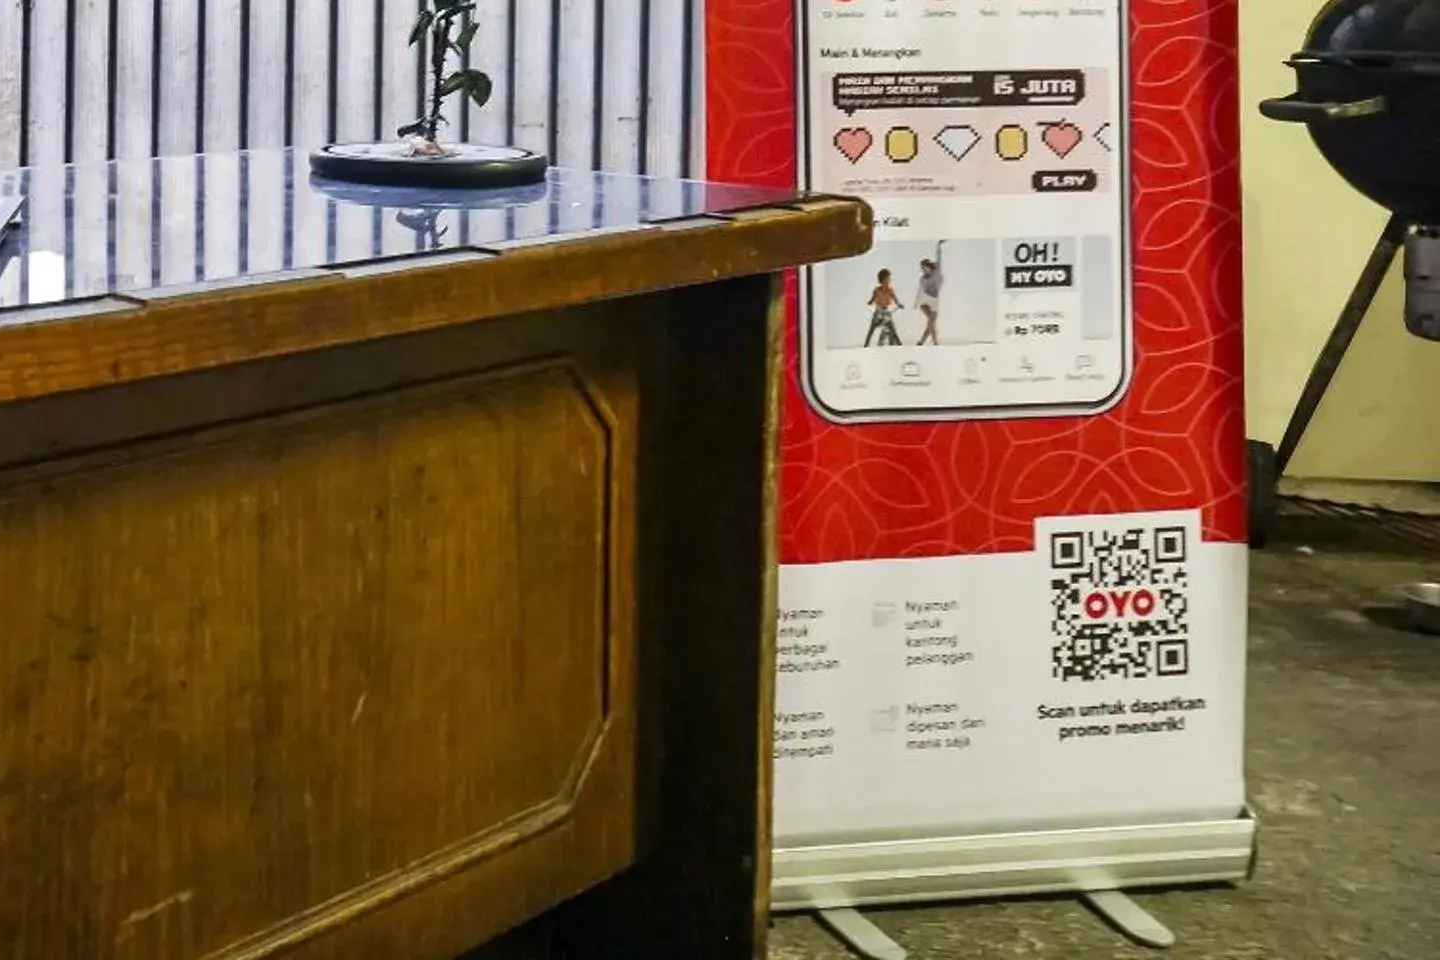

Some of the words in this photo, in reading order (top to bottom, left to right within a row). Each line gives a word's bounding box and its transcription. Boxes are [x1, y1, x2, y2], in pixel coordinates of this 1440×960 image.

[1020, 80, 1076, 94] JUTA
[1042, 175, 1086, 187] PLAY
[1011, 271, 1032, 284] MY
[1034, 269, 1066, 283] OYO
[1084, 589, 1155, 619] OYO
[779, 625, 808, 638] ntuk
[1037, 704, 1075, 720] Scan
[1079, 700, 1126, 717] untuk
[1130, 696, 1206, 714] dapatkan
[1059, 724, 1111, 742] promo
